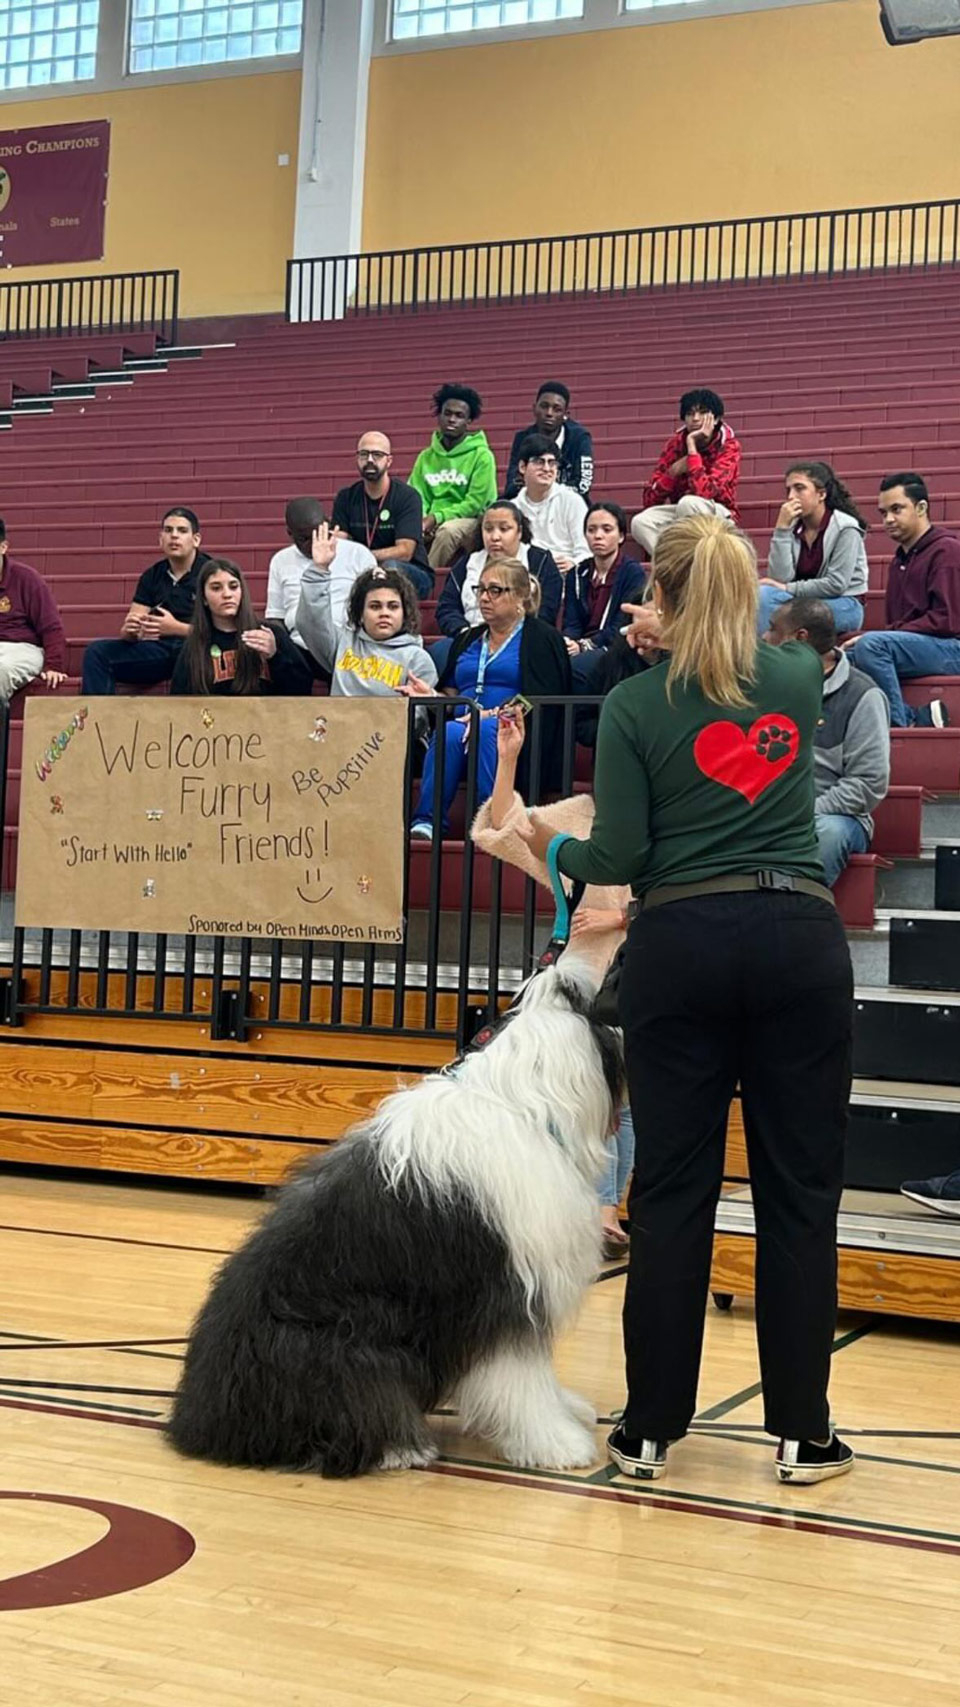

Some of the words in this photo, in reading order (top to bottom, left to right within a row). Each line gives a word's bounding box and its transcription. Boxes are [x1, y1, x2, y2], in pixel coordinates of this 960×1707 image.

[26, 137, 99, 154] CHAMPIONS
[50, 217, 80, 228] States
[95, 720, 266, 775] Welcome
[292, 767, 323, 794] Be
[181, 776, 271, 822] Furry
[247, 920, 262, 935] by
[368, 925, 402, 942] Arms
